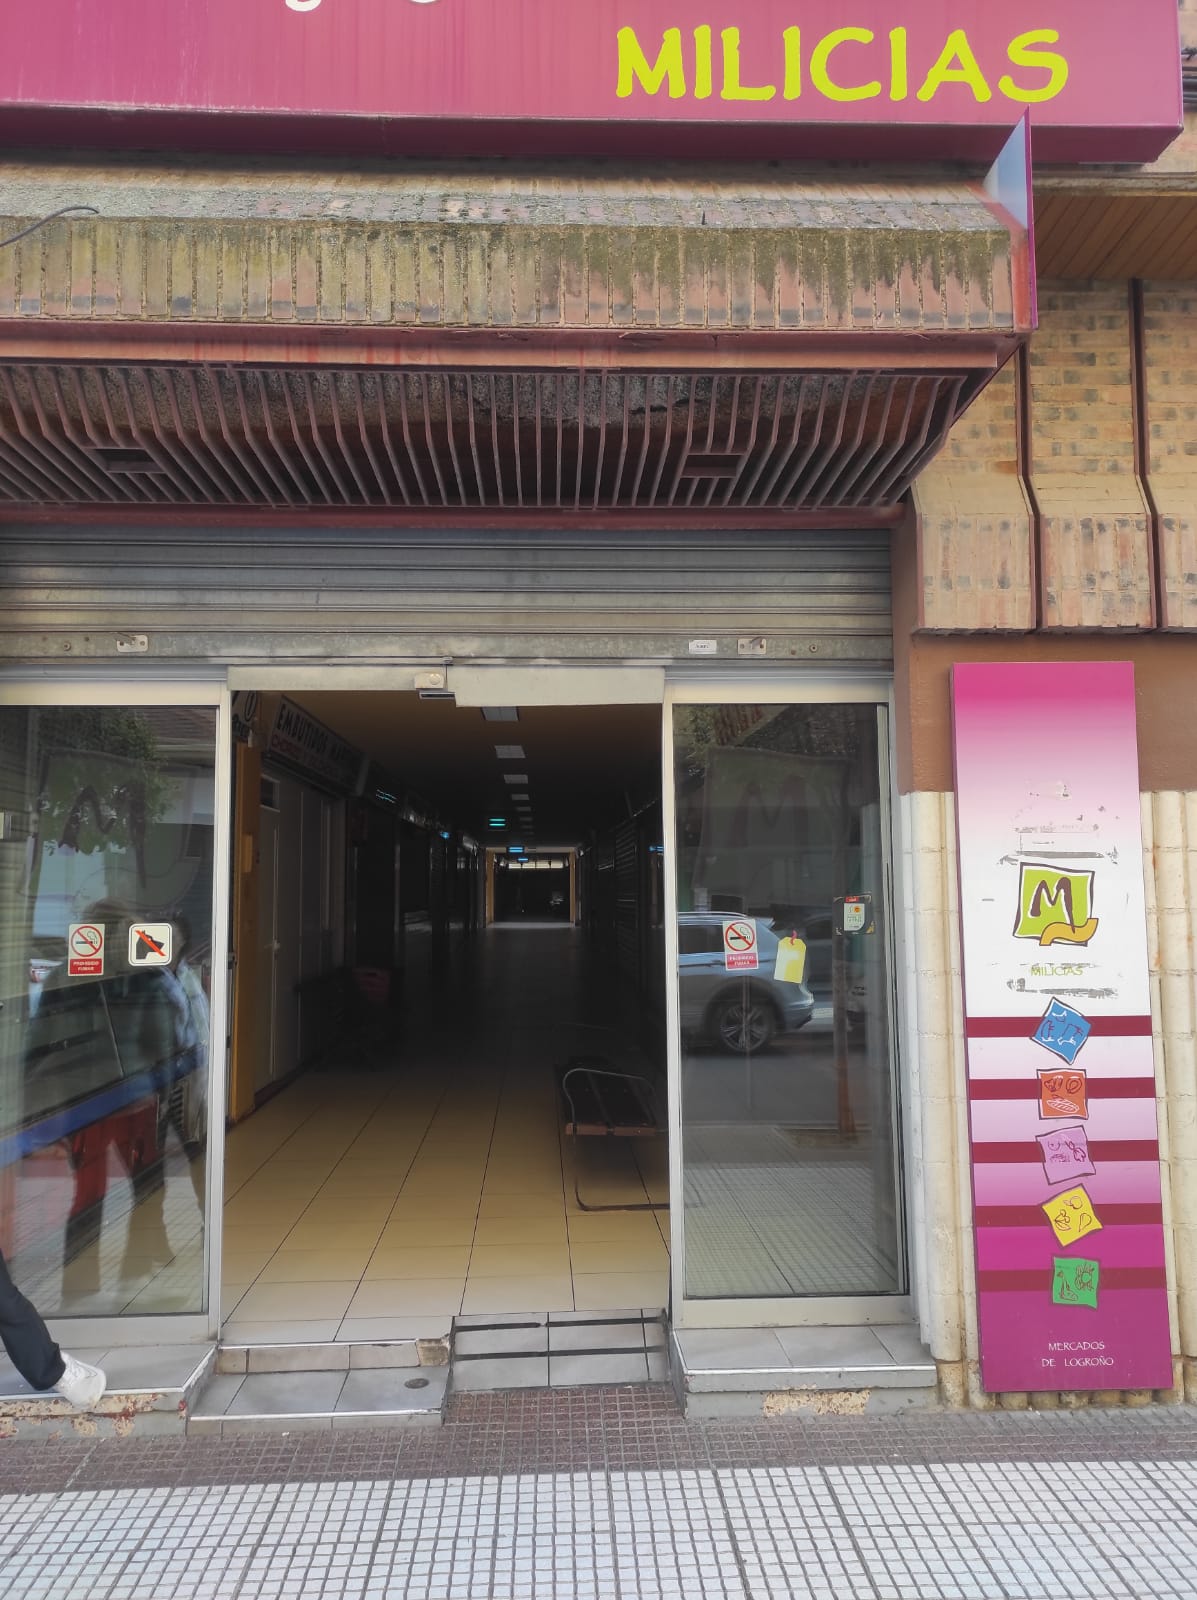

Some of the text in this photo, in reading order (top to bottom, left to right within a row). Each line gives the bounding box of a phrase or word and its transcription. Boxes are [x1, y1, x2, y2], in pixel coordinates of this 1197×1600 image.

[616, 25, 1069, 103] MILICIAS
[1029, 876, 1076, 934] M
[1030, 966, 1084, 977] MILICIAS
[1048, 1341, 1105, 1351] MERCADOS
[1041, 1355, 1114, 1367] DE LOGROÑO
